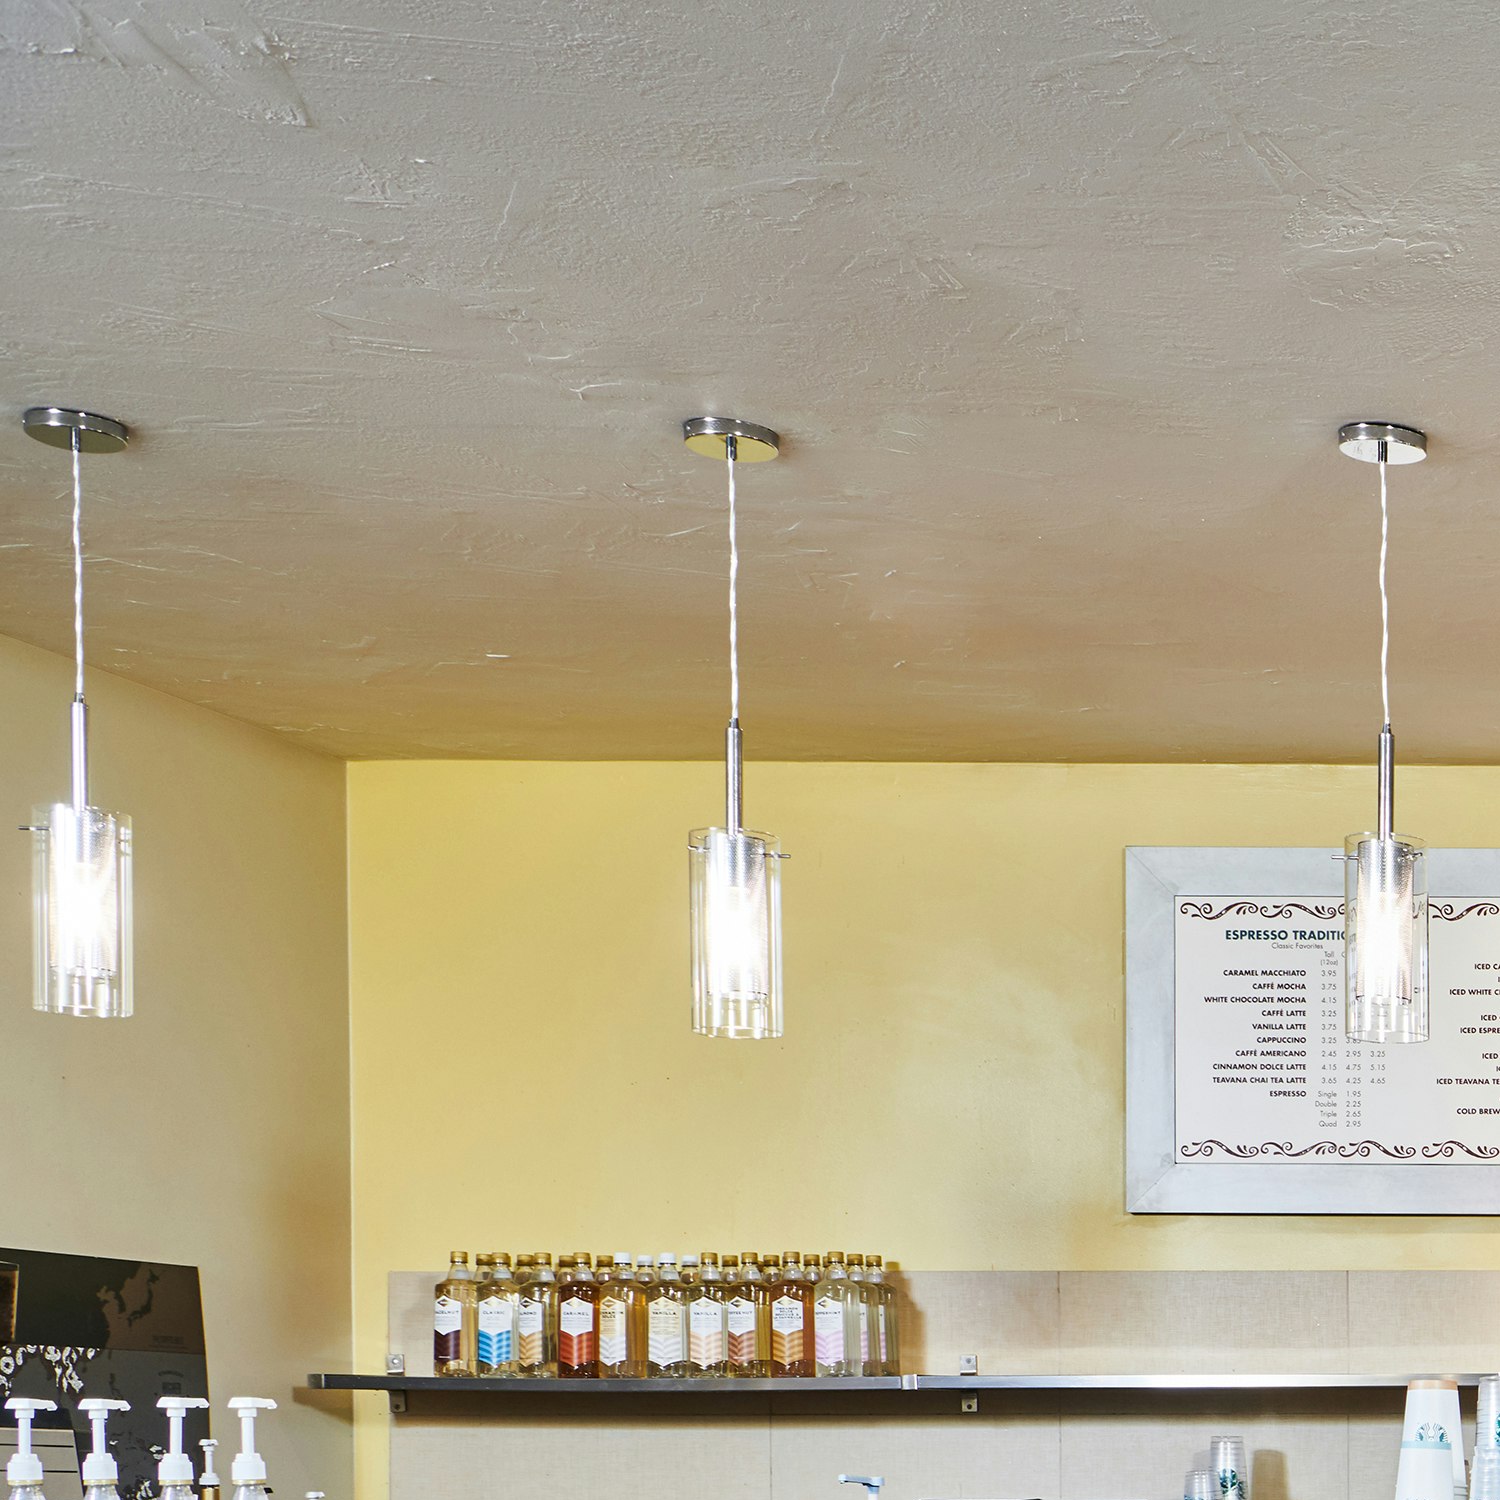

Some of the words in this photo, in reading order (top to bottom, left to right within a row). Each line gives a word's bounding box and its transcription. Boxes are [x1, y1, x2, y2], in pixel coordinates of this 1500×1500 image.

[1225, 929, 1289, 942] ESPRESSO
[1291, 929, 1346, 942] TRADITI
[1474, 963, 1492, 971] ICED
[1222, 969, 1259, 977] CARAMEL
[1260, 969, 1307, 977] MACCHIATO
[1321, 969, 1337, 978] 3.95
[1276, 982, 1307, 991] MOCHA
[1203, 996, 1228, 1004] WHITE
[1229, 996, 1275, 1004] CHOCOLATE
[1276, 996, 1307, 1004] MOCHA
[1459, 1026, 1477, 1034] ICED
[1256, 1036, 1307, 1044] CAPPUCCINO
[1481, 1052, 1499, 1060] ICED
[1212, 1063, 1258, 1071] CINNAMON
[1259, 1063, 1284, 1071] DOLCE
[1285, 1063, 1307, 1071] LATTE
[1212, 1076, 1248, 1084] TEAVANA
[1249, 1076, 1269, 1084] CHAI
[1270, 1076, 1285, 1084] TEA
[1285, 1076, 1307, 1084] LATTE
[1456, 1107, 1477, 1115] COLD
[1478, 1107, 1500, 1115] BREW
